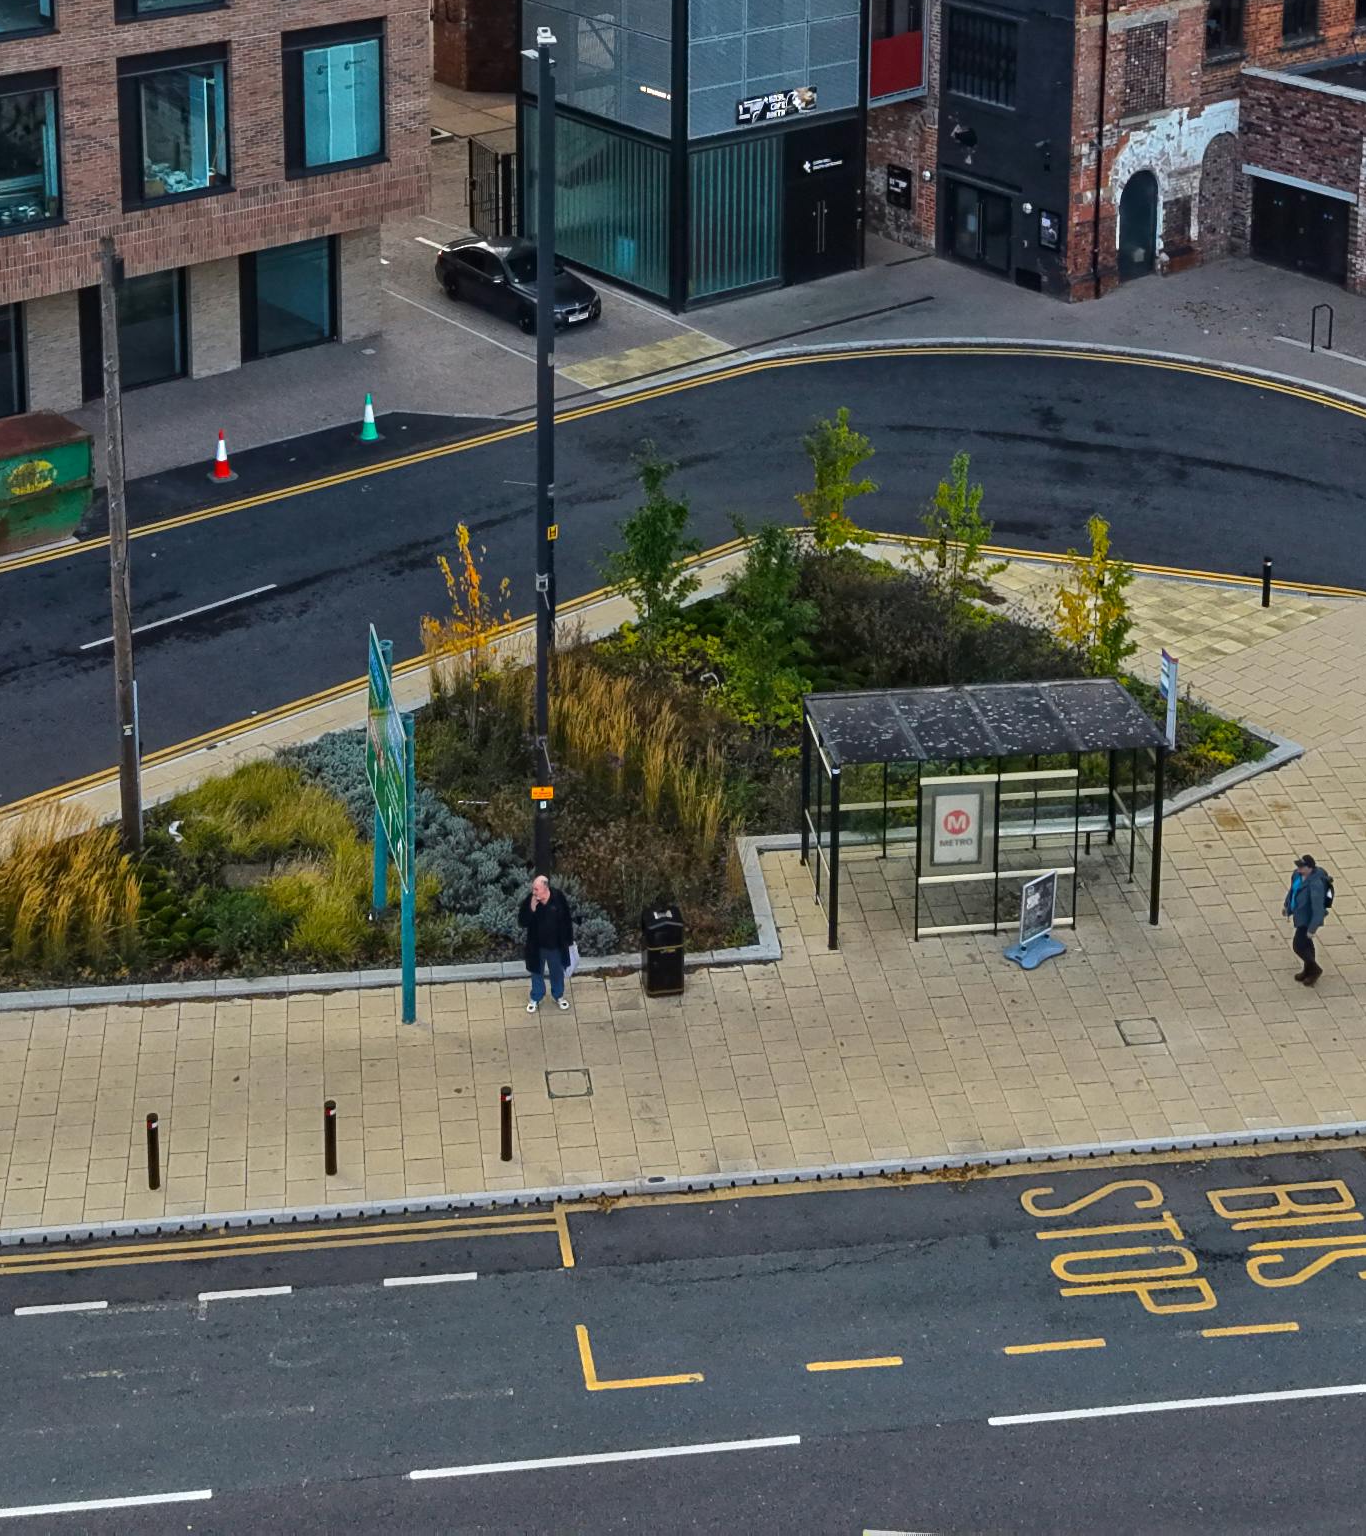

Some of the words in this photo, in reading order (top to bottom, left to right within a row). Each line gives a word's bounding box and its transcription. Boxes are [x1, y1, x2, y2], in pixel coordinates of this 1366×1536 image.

[946, 814, 967, 831] M
[938, 837, 974, 848] METRO
[1019, 1178, 1218, 1315] STOP
